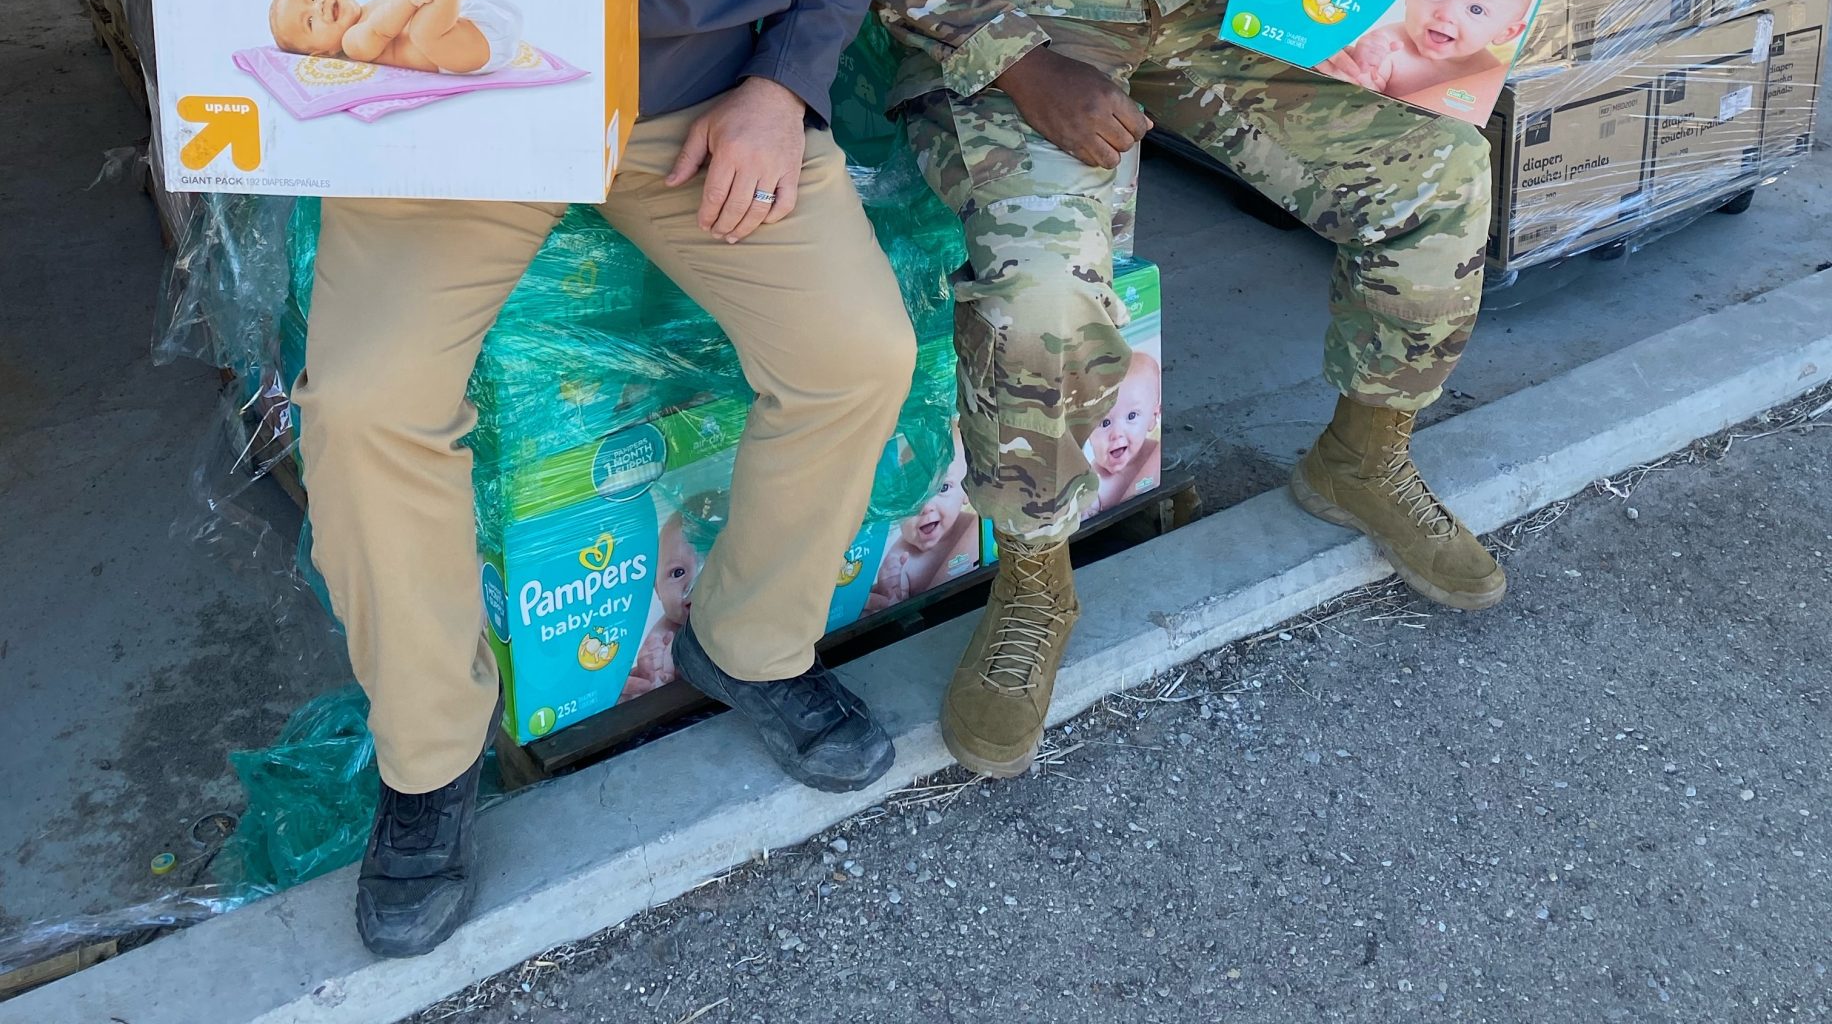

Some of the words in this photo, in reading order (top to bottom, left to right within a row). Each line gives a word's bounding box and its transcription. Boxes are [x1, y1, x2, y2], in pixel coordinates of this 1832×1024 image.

[1243, 14, 1252, 31] 1
[1261, 24, 1285, 42] 252
[204, 103, 250, 115] up&up
[1660, 127, 1694, 145] couches
[1521, 170, 1562, 188] couches
[1569, 155, 1610, 180] pañales
[1522, 153, 1563, 172] diapers
[181, 176, 213, 185] GIANT
[215, 176, 243, 185] PACK
[245, 177, 260, 186] 192
[613, 437, 648, 457] PAMPERS
[603, 462, 613, 477] 1
[613, 443, 653, 467] MONTH
[615, 452, 654, 474] SUPPLY
[519, 553, 648, 626] Pampers
[540, 593, 633, 643] baby-dry
[537, 710, 546, 727] 1
[557, 700, 578, 719] 252
